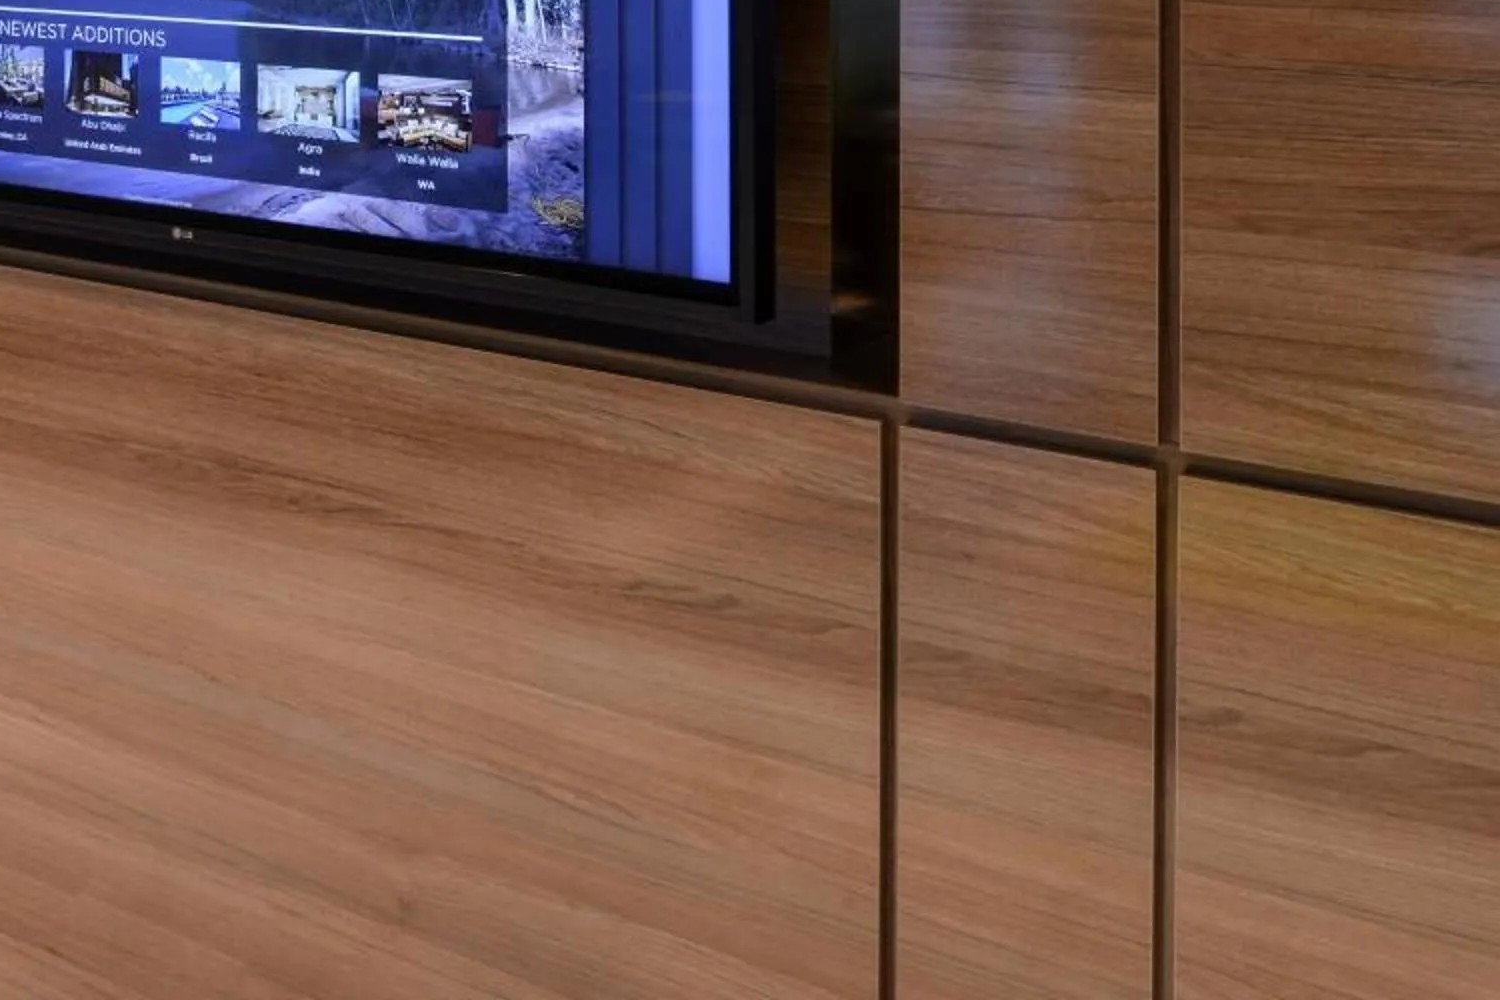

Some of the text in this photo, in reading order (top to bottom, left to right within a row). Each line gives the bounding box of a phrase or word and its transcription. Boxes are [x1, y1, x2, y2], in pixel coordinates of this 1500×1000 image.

[0, 20, 67, 40] NEWEST
[71, 26, 167, 48] ADDITIONS
[81, 118, 98, 130] Abu
[297, 143, 323, 156] Agra
[395, 152, 459, 169] Walla Walla
[417, 179, 436, 190] WA
